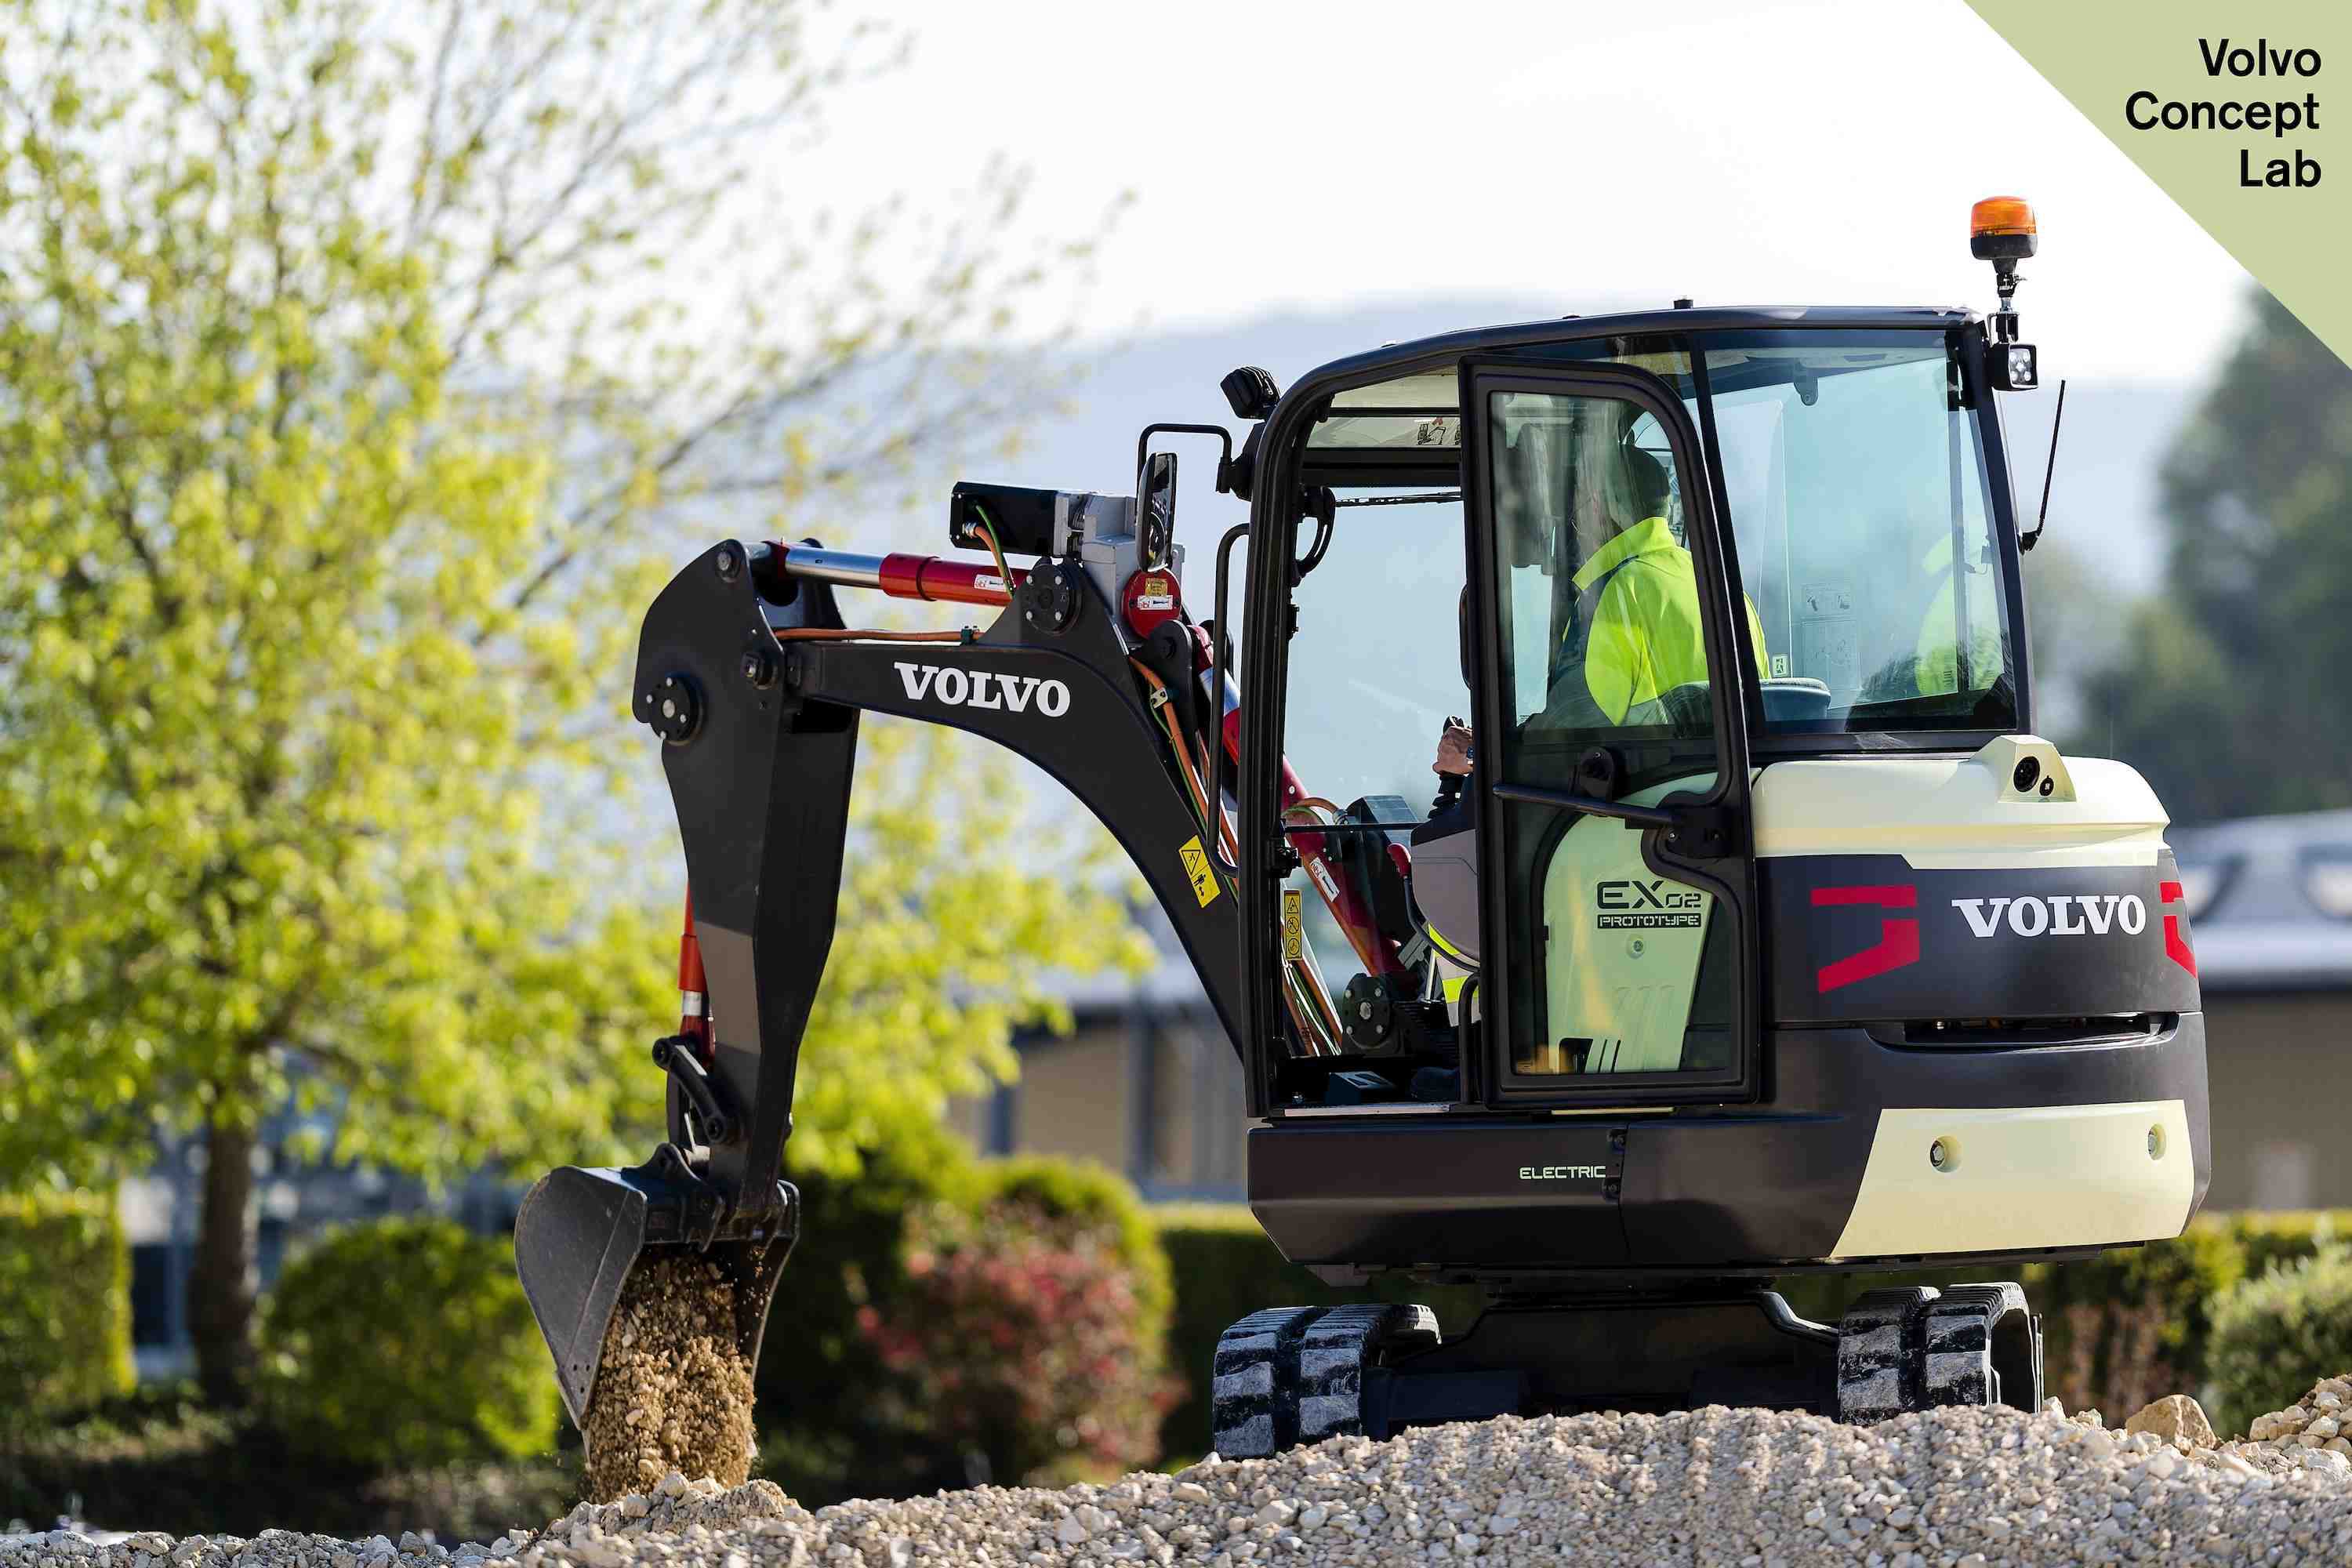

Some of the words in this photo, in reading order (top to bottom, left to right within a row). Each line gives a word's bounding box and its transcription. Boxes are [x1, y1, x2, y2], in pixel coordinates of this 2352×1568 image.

[894, 661, 1071, 718] VOLVO
[1599, 914, 1700, 927] PROTOTYPE
[1951, 894, 2147, 938] VOLVO
[1519, 1165, 1606, 1180] ELECTRIC
